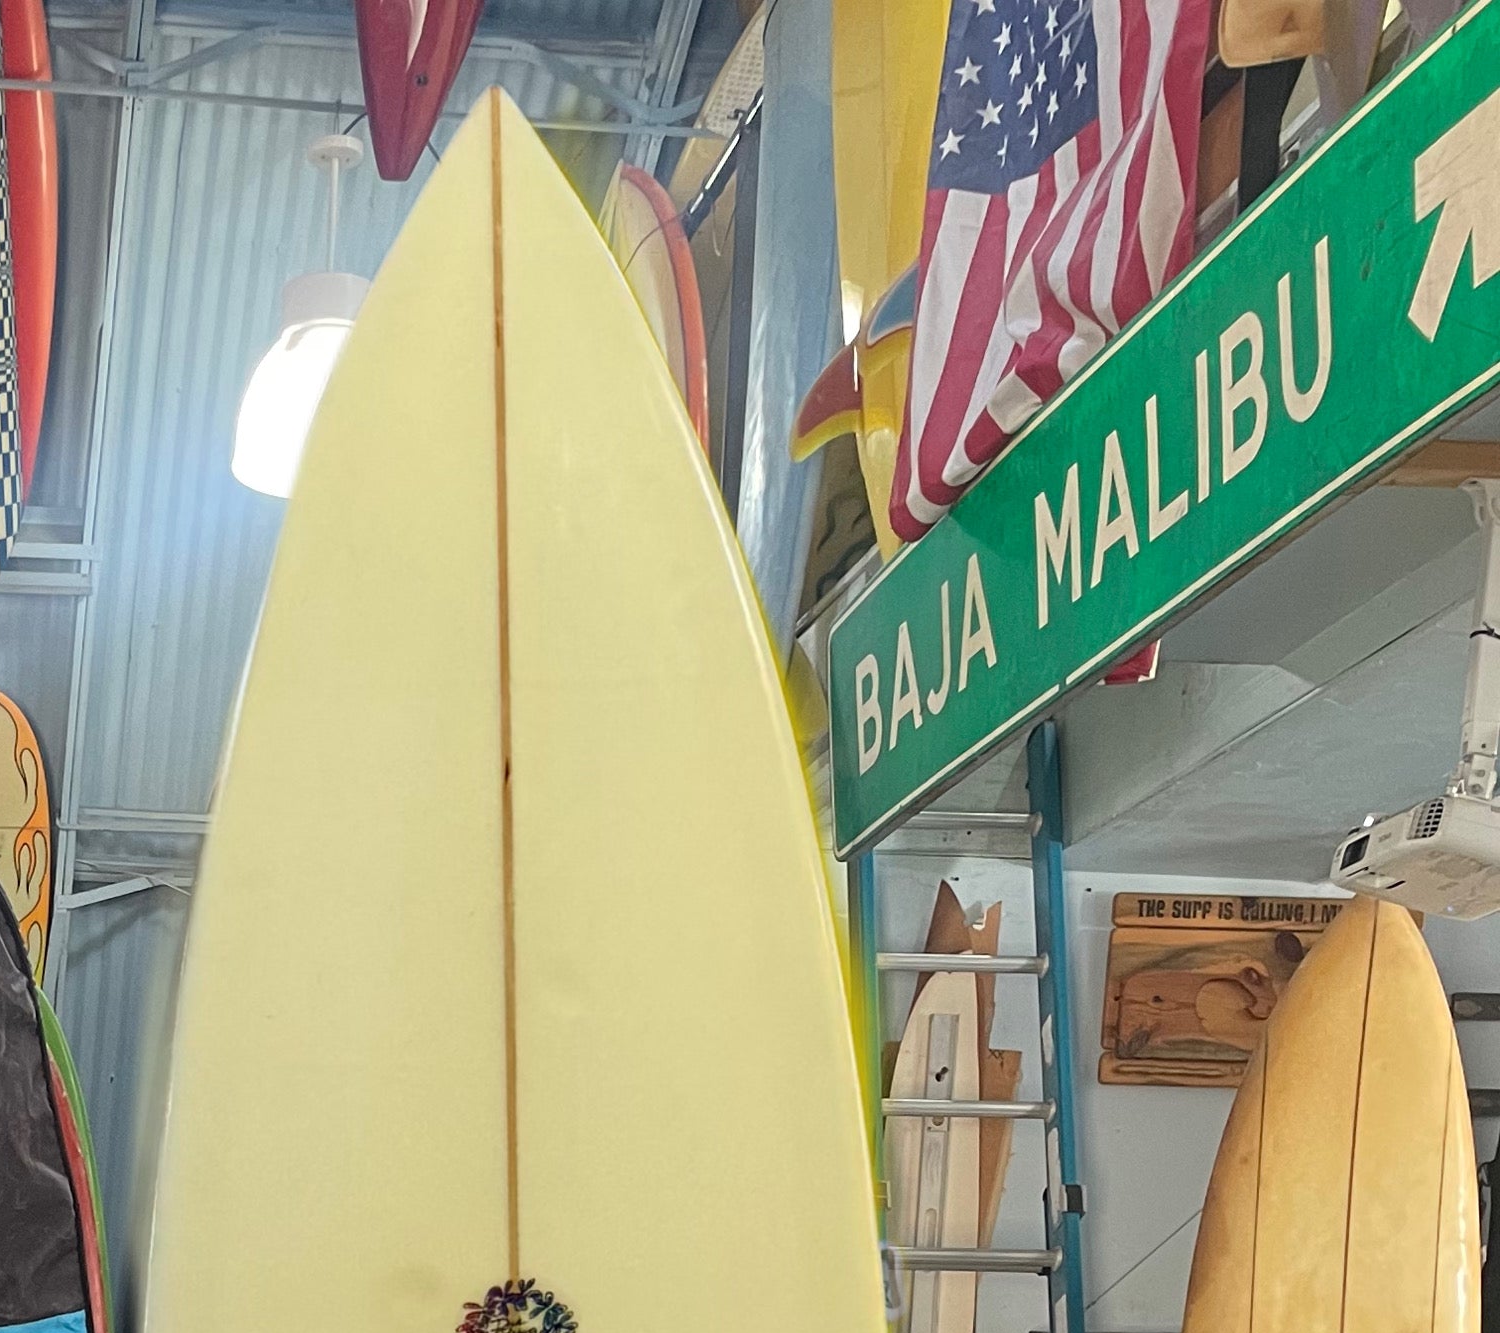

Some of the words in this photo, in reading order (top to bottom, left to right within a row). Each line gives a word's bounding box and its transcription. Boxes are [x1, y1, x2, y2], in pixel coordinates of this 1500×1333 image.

[856, 553, 997, 777] BAJA
[1034, 235, 1332, 630] MALIBU
[1218, 902, 1234, 920] IS
